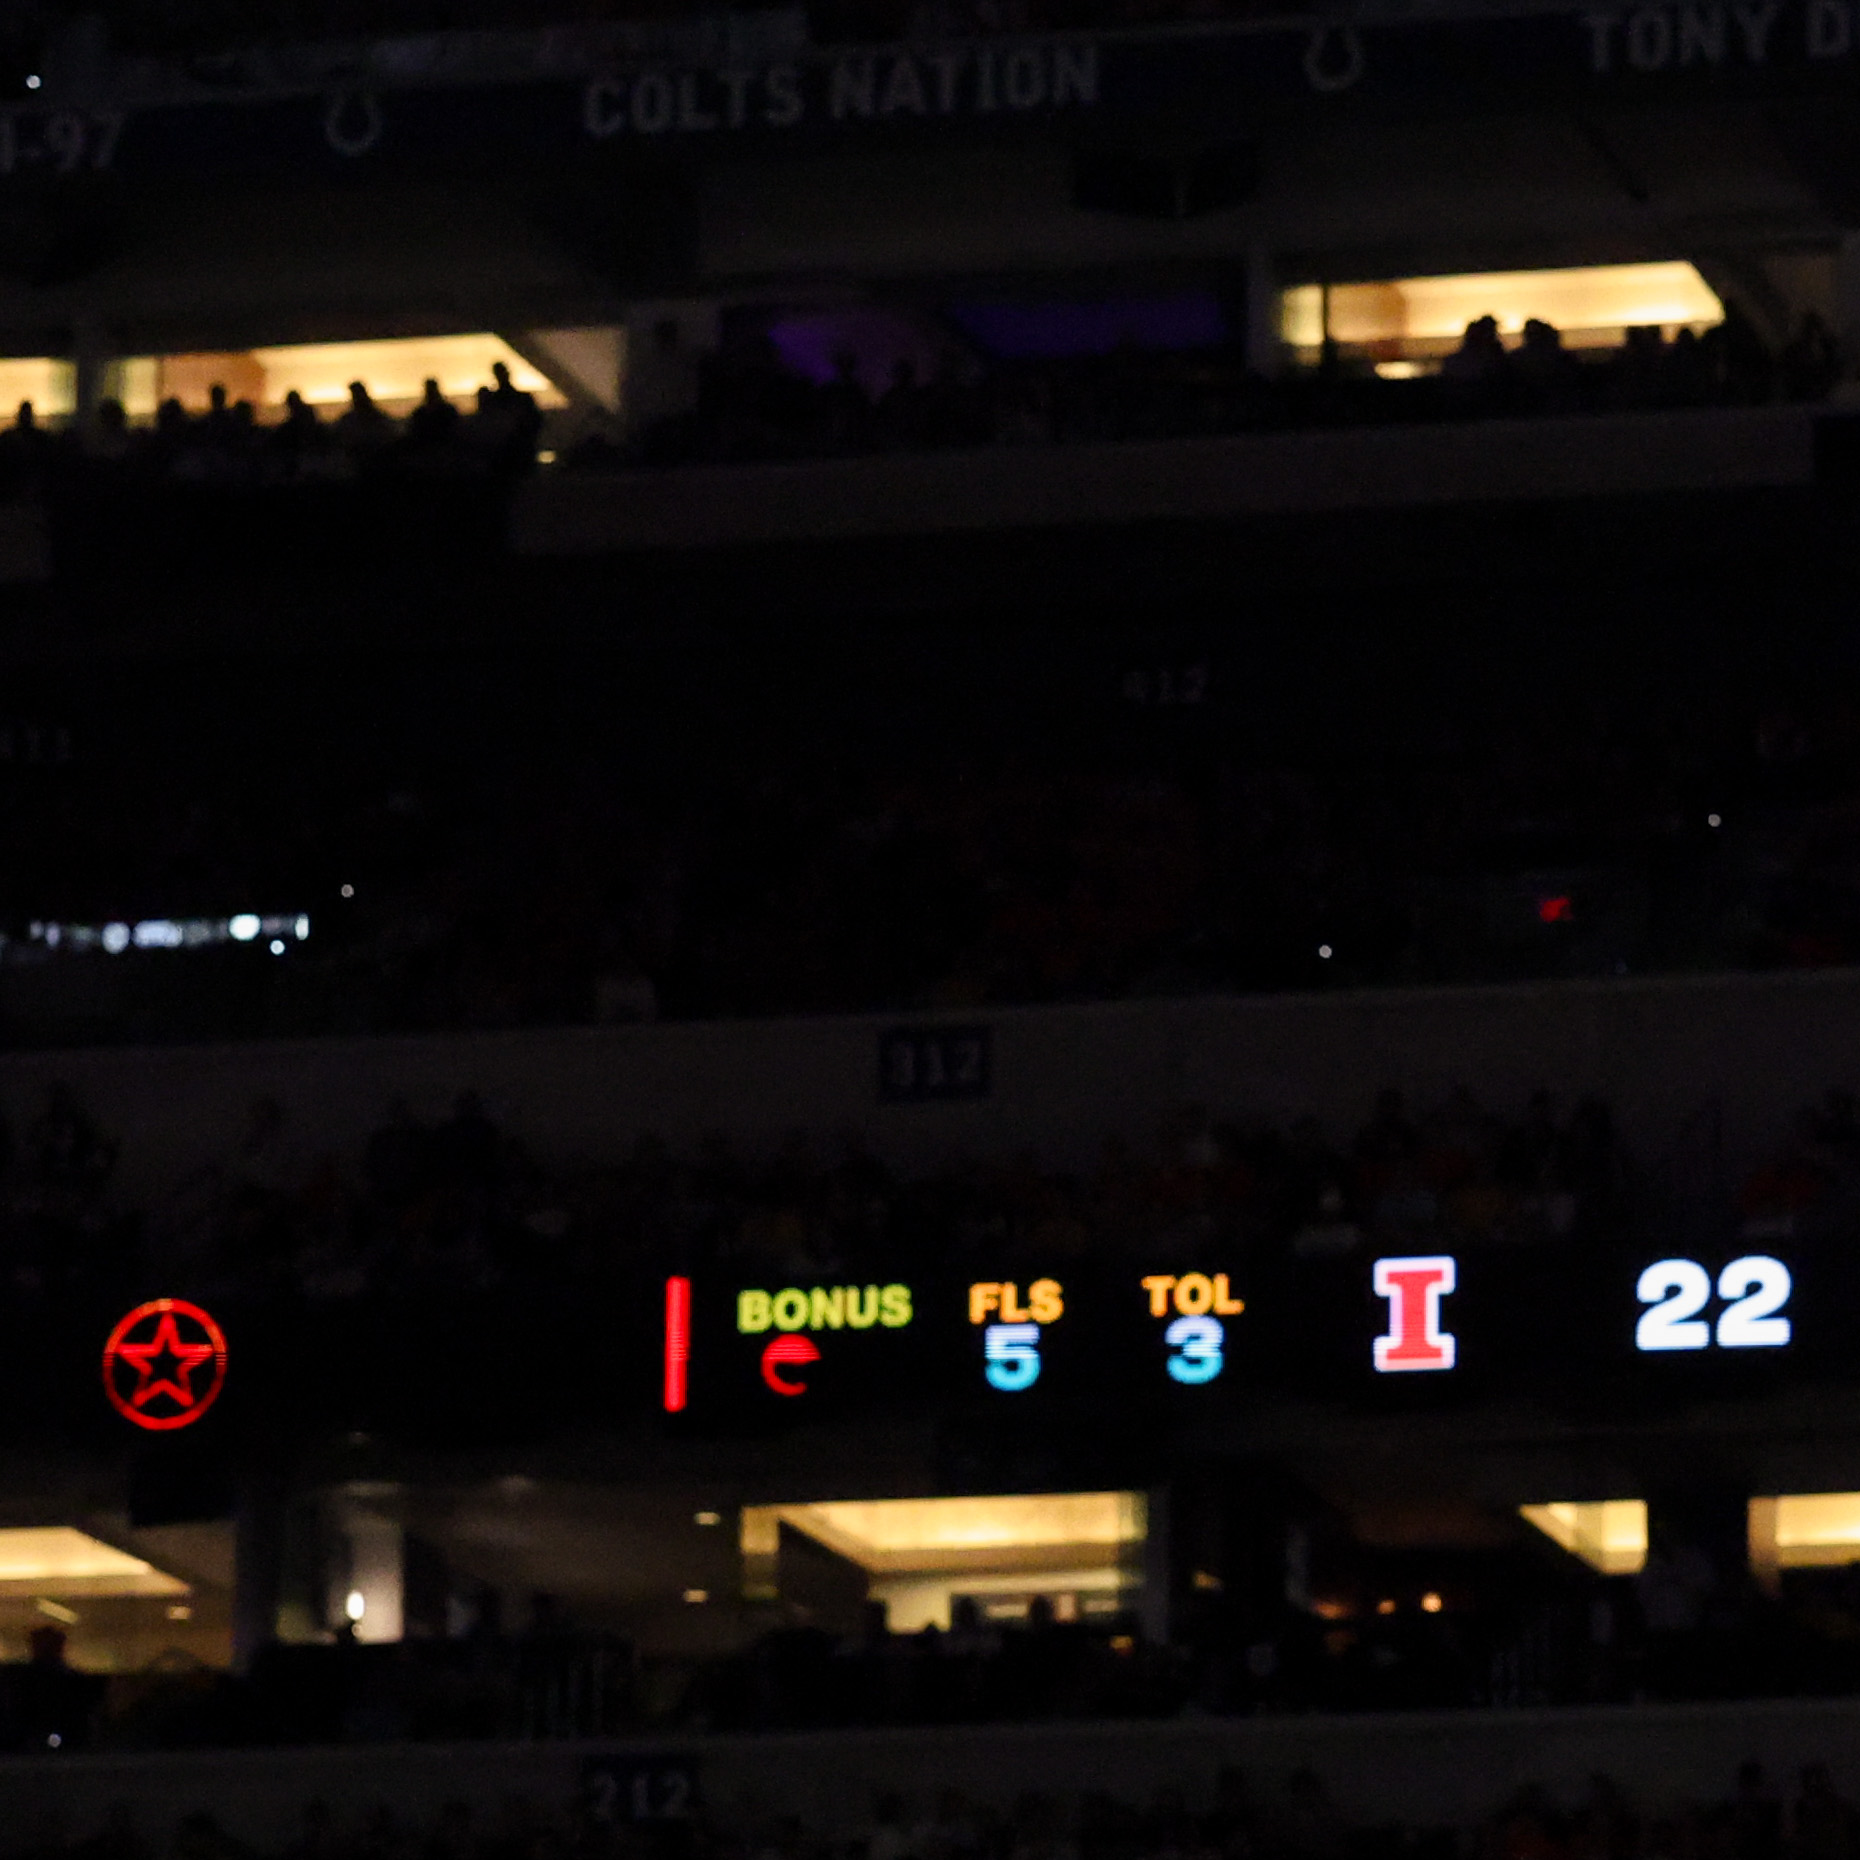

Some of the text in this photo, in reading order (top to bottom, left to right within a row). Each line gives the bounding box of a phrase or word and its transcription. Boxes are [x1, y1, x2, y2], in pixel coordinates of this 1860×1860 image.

[1580, 2, 1776, 74] TONY
[584, 42, 1100, 138] COLTS NATION
[736, 1284, 913, 1334] BONUS
[967, 1277, 1064, 1325] FLS
[1140, 1271, 1244, 1318] TOL
[1635, 1255, 1792, 1351] 22
[984, 1323, 1041, 1392] 5
[1164, 1314, 1224, 1385] 3
